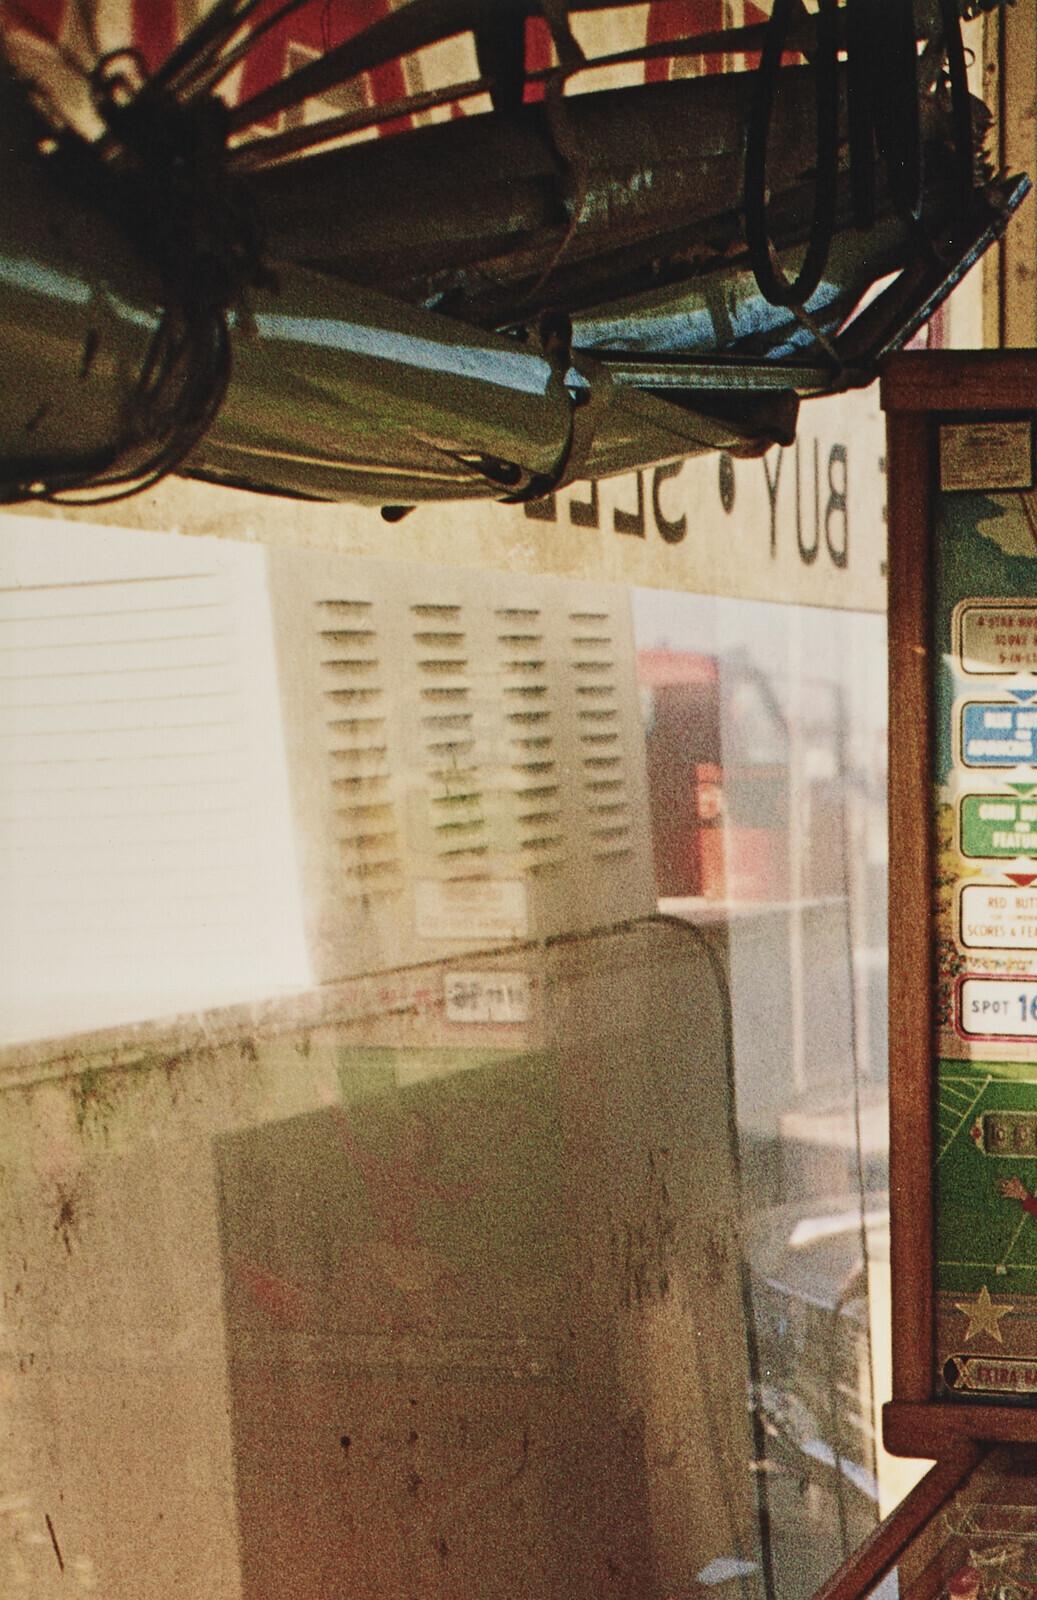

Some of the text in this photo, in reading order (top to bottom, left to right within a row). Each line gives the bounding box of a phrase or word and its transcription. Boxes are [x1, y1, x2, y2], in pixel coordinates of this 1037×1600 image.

[987, 896, 1008, 909] RED
[967, 925, 1006, 938] SCORES
[971, 1000, 1008, 1014] SPOT
[976, 1367, 1019, 1384] EXTRA
